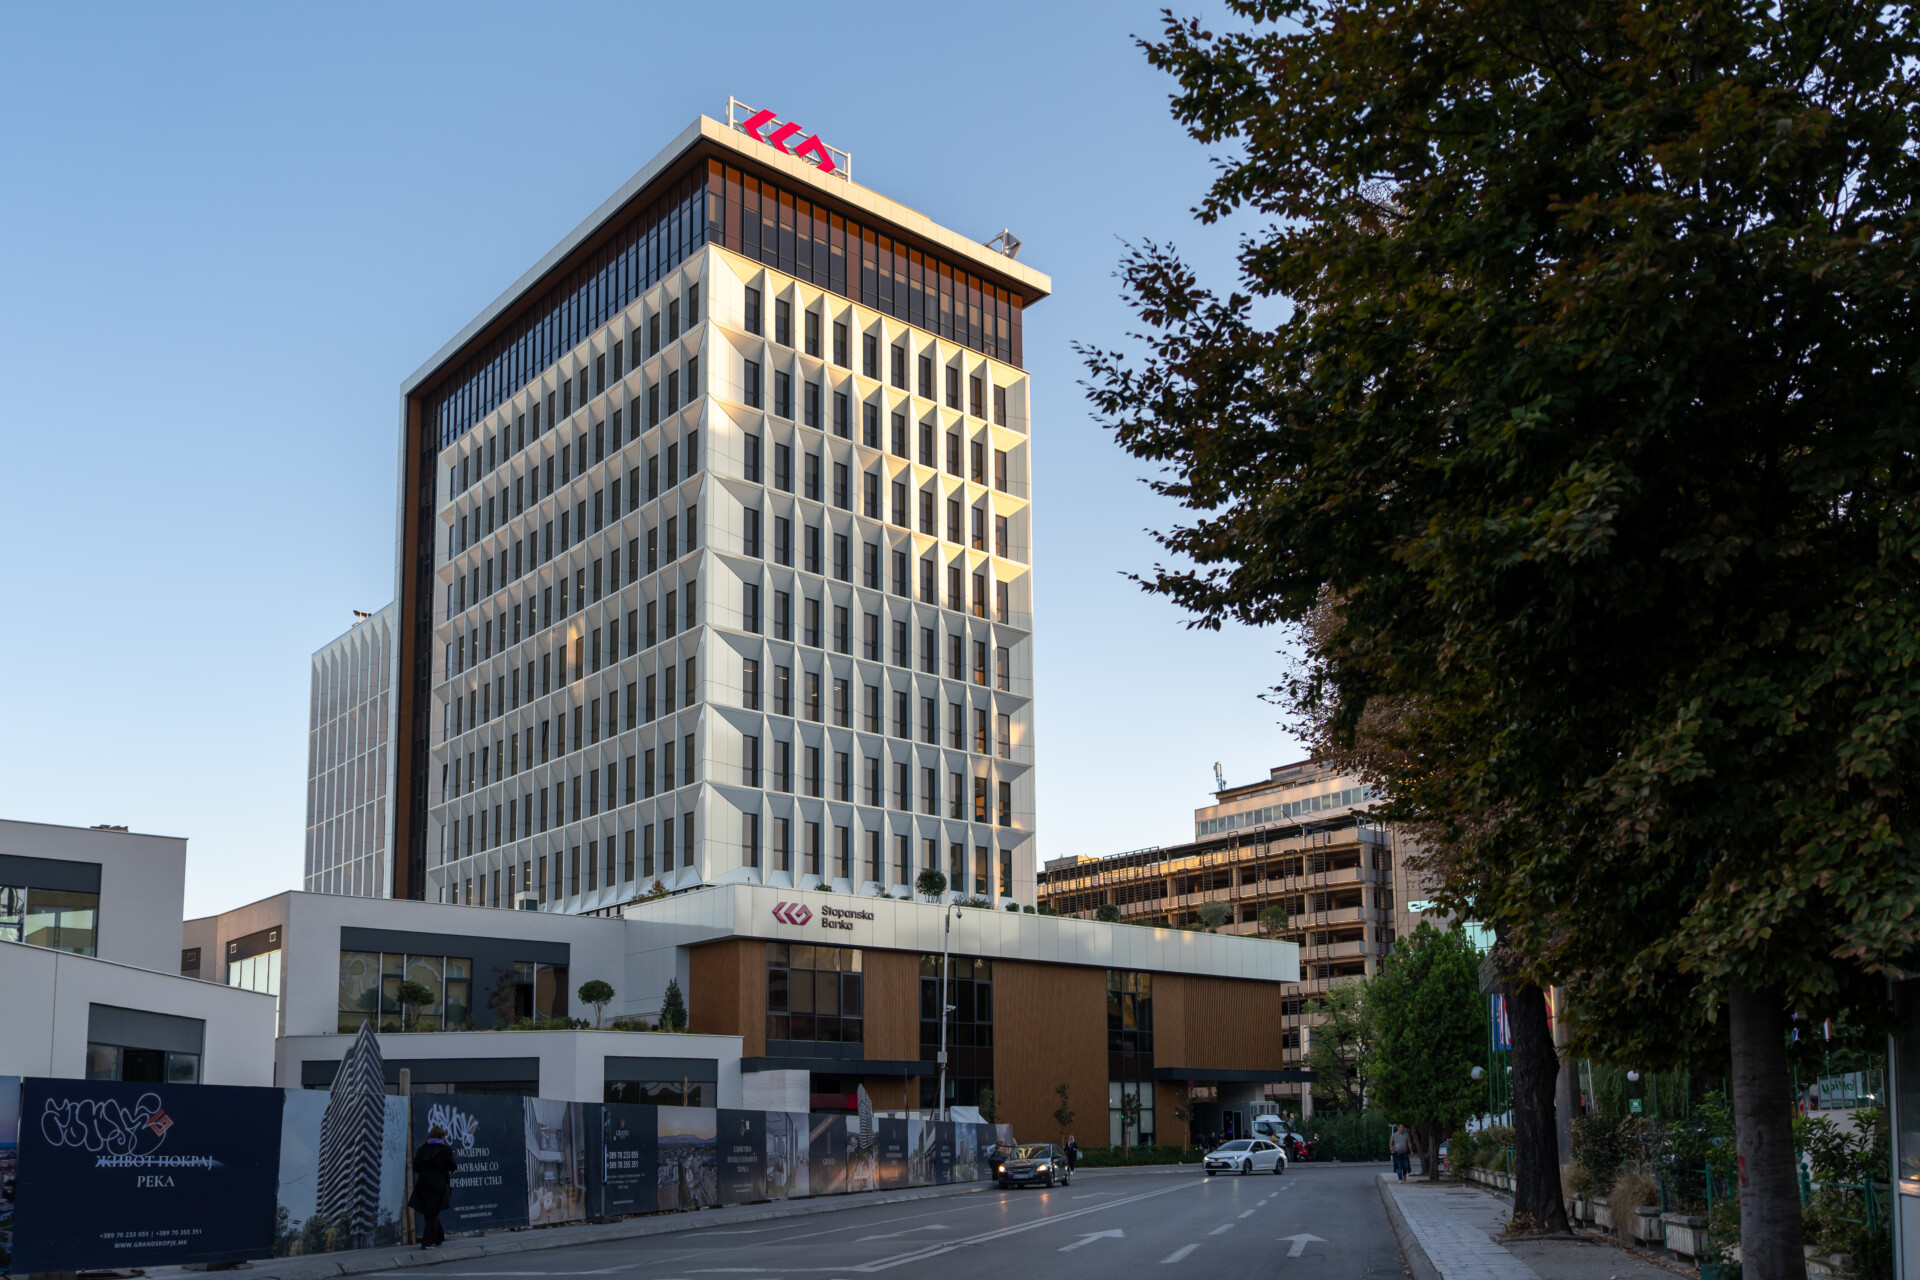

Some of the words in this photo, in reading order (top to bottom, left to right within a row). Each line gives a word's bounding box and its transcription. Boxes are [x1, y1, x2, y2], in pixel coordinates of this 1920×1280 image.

[821, 905, 874, 921] Stopanska
[821, 917, 853, 930] Banka
[456, 1147, 490, 1158] МОДЕРНО
[449, 1161, 489, 1174] ОМУВАЊЕ
[137, 1175, 175, 1188] РЕКА
[114, 1240, 188, 1249] WWW.GRANDSKOPJE.MK
